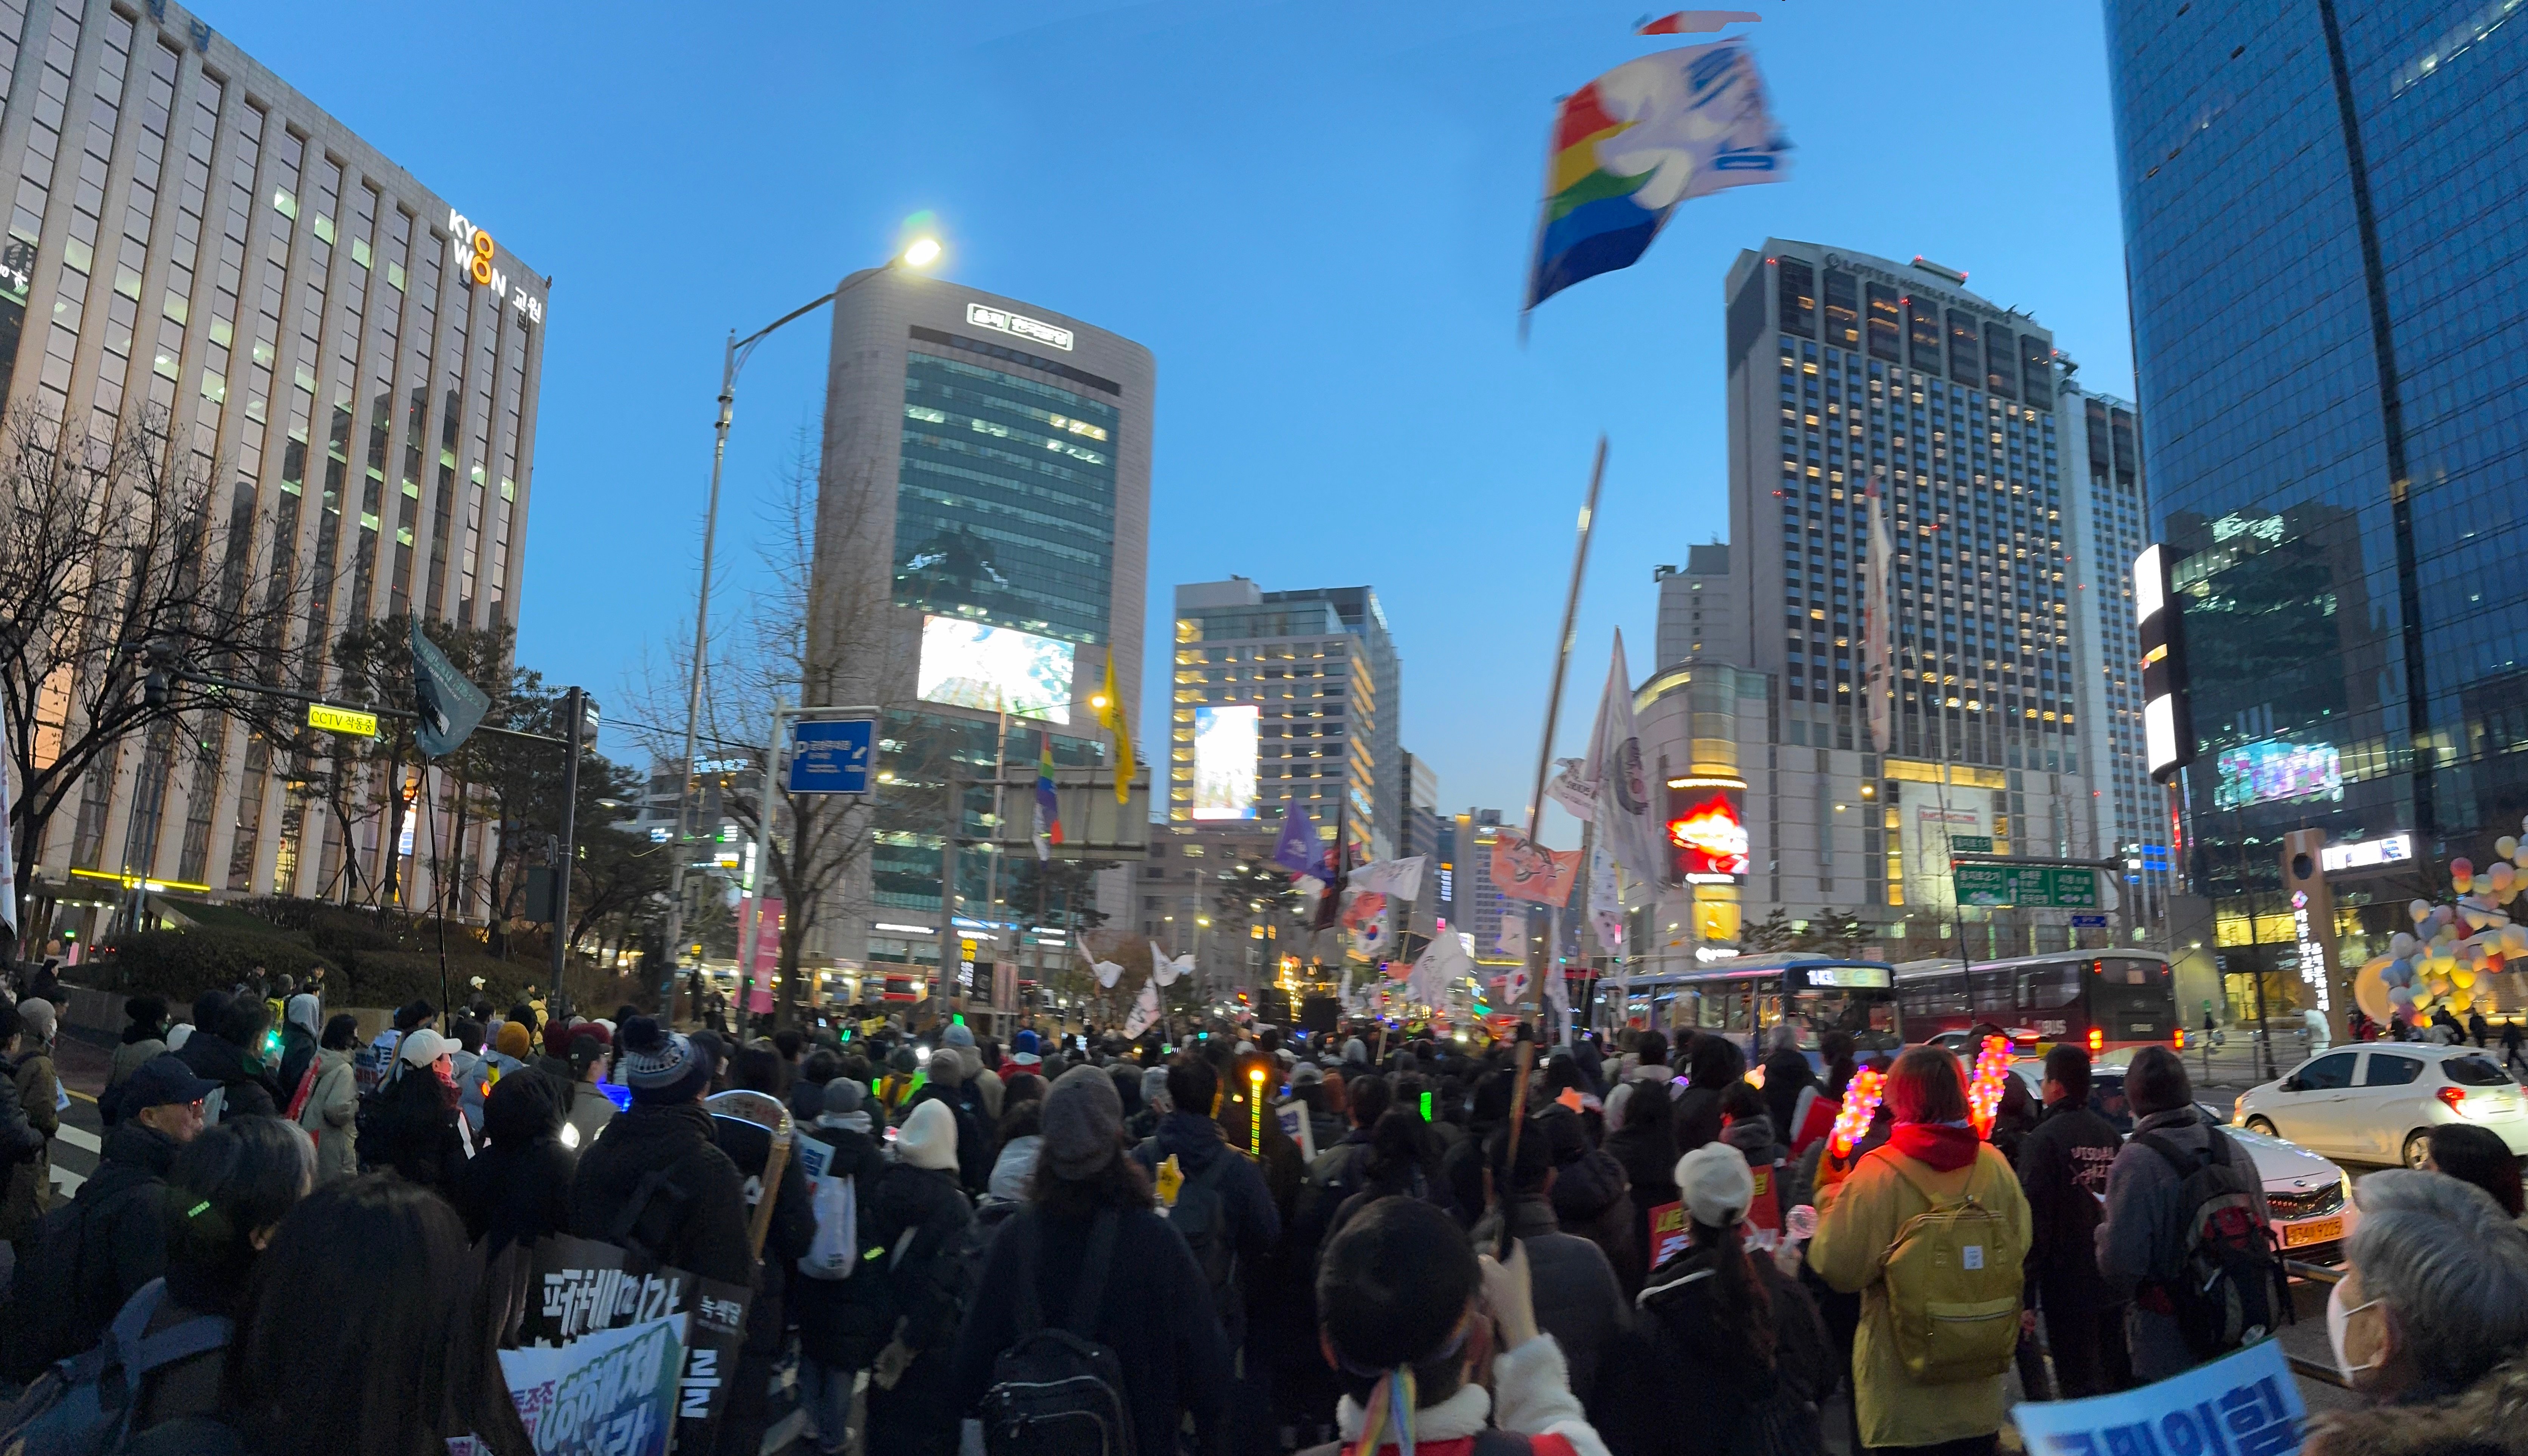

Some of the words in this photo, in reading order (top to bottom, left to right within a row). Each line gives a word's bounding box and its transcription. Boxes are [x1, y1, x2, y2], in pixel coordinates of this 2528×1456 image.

[449, 208, 494, 259] KYO
[453, 238, 506, 298] WON
[512, 286, 542, 324] 교원
[311, 711, 342, 726] CCTV
[346, 716, 373, 732] 작동중
